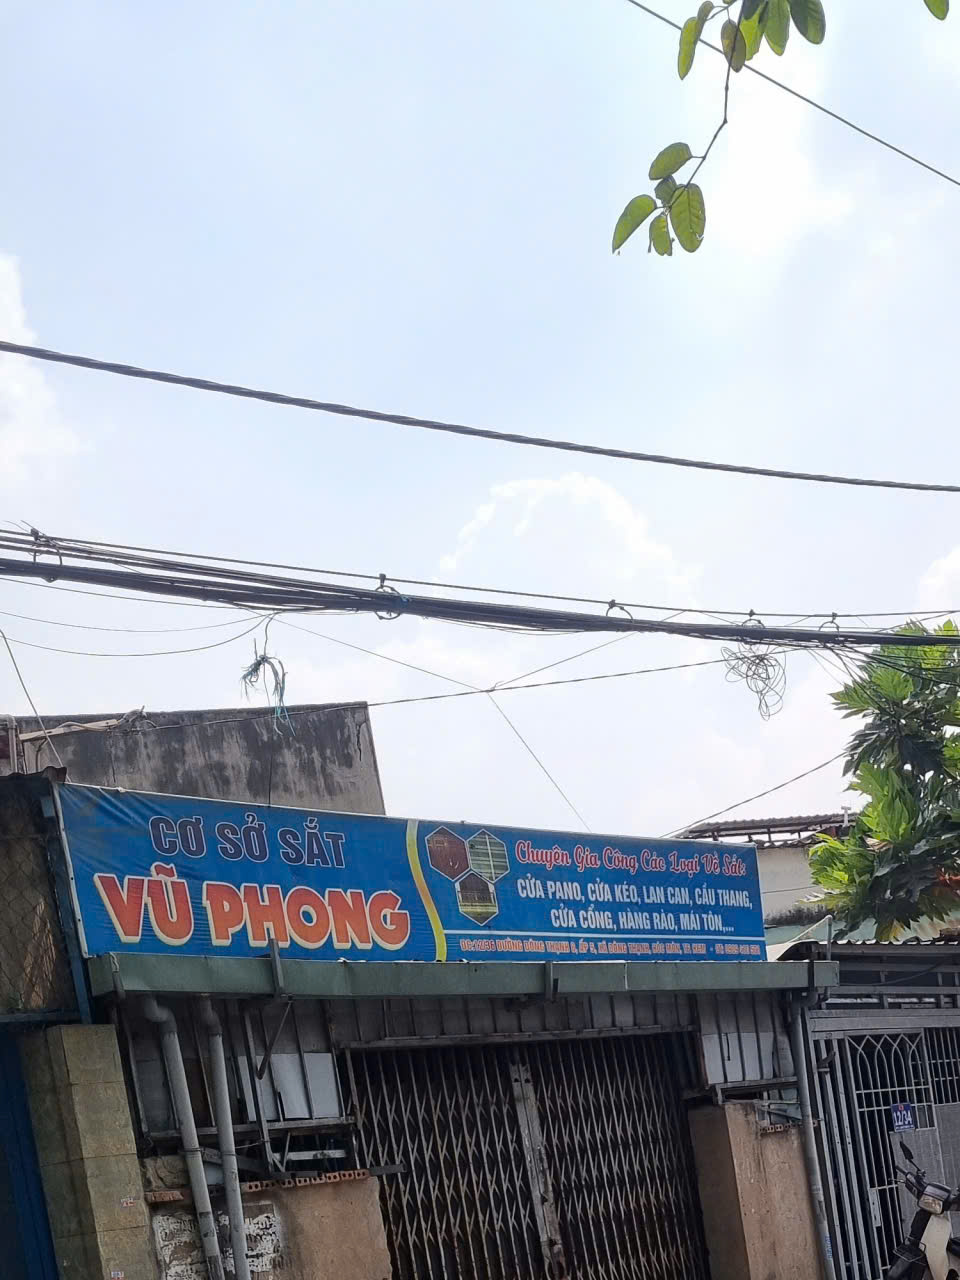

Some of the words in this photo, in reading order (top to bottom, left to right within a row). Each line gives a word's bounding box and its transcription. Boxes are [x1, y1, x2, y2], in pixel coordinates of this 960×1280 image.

[149, 815, 207, 858] CƠ
[215, 813, 269, 862] SỞ
[277, 817, 345, 868] SẮT
[515, 840, 571, 871] Chuyên
[574, 845, 600, 872] Gia
[603, 846, 638, 875] Công
[641, 849, 666, 872] Các
[668, 851, 701, 878] Loại
[93, 861, 194, 946] VŨ
[202, 881, 411, 950] PHONG
[517, 873, 545, 899] CỬA
[547, 881, 585, 903] PANO,
[587, 877, 612, 902] CỬA
[614, 881, 641, 905] KÉO,
[642, 885, 665, 904] LAN
[667, 886, 693, 907] CAN,
[717, 889, 753, 910] THANG,
[550, 903, 577, 928] CỬA
[579, 904, 617, 931] CỔNG,
[618, 907, 650, 930] HÀNG
[653, 909, 678, 932] RÀO,
[679, 910, 701, 930] MÁI
[893, 1110, 912, 1125] 12/34
